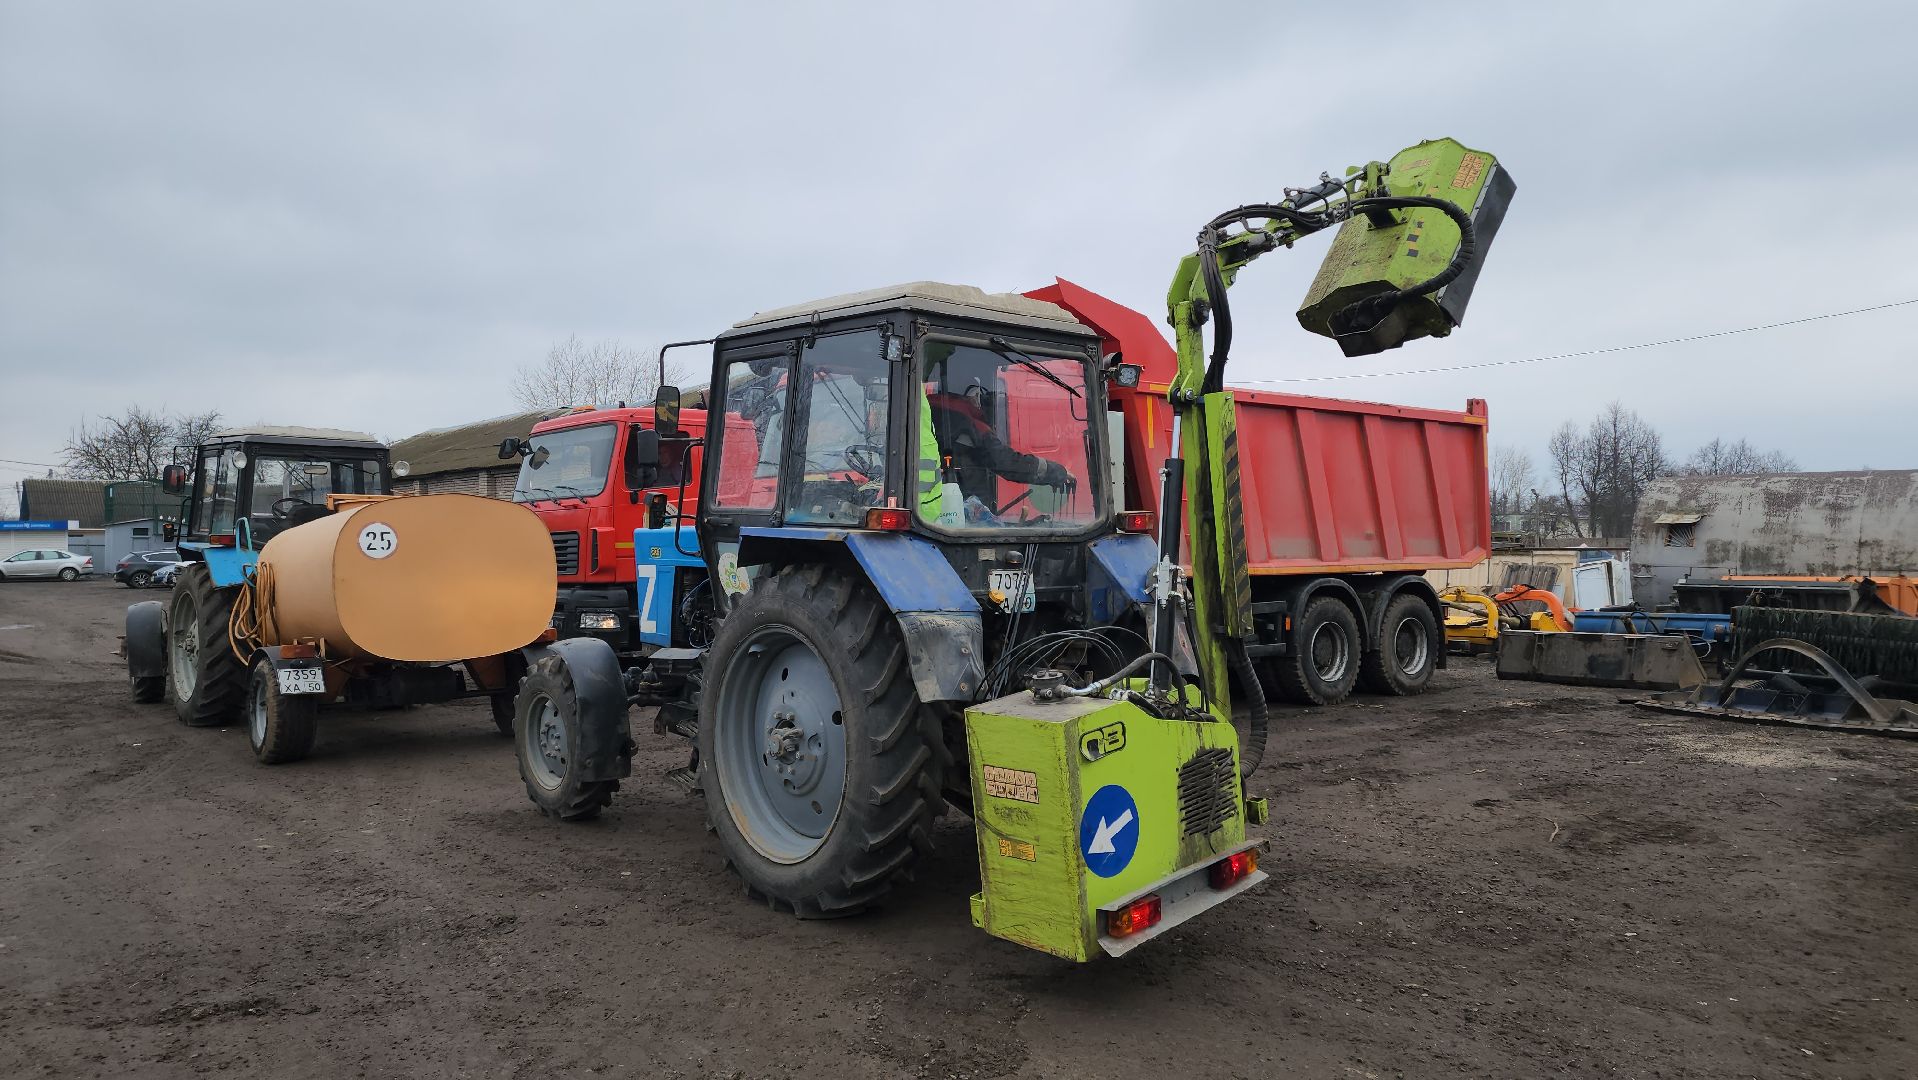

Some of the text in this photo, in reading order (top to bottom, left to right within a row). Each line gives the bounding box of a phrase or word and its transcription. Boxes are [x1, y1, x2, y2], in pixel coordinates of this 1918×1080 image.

[366, 531, 392, 551] 25
[283, 669, 317, 681] 7359
[308, 682, 321, 692] 50
